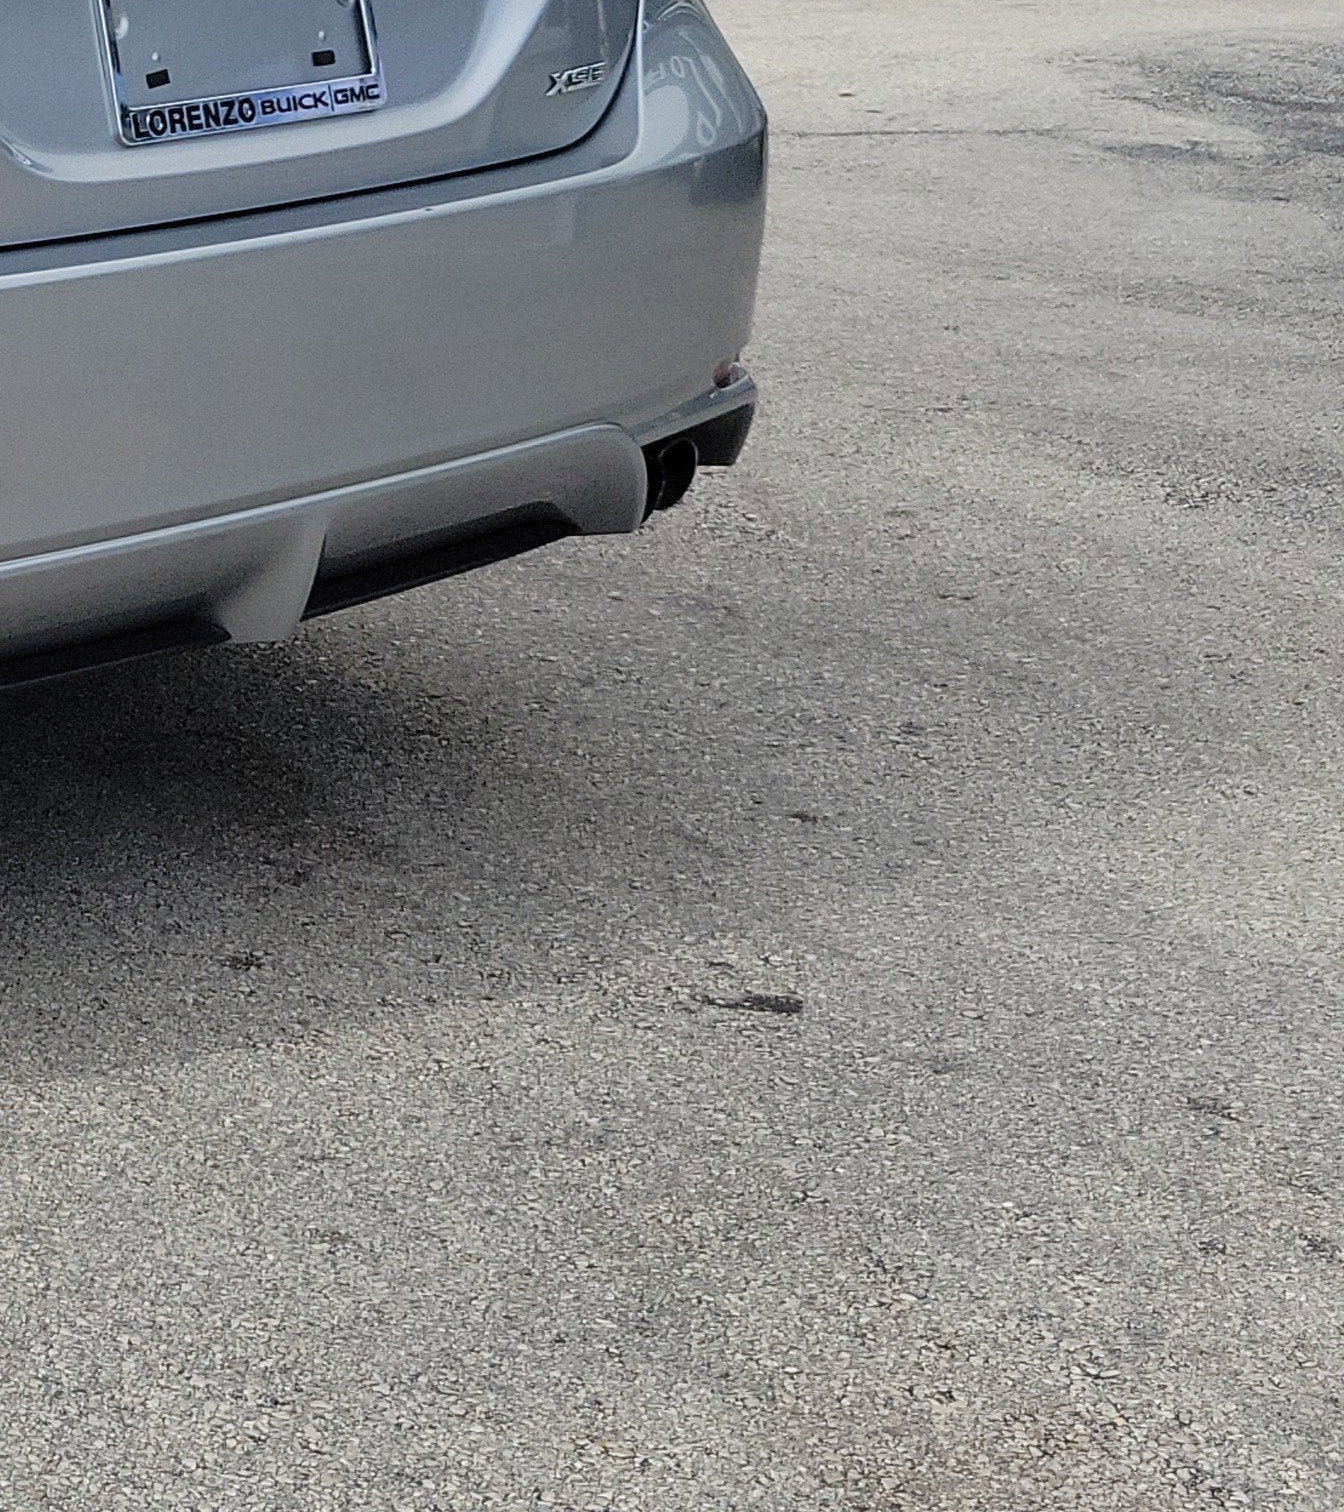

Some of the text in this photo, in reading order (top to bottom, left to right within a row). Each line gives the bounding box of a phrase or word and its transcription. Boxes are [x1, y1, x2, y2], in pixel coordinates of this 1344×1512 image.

[132, 83, 380, 139] LORENZO BUICK GMC
